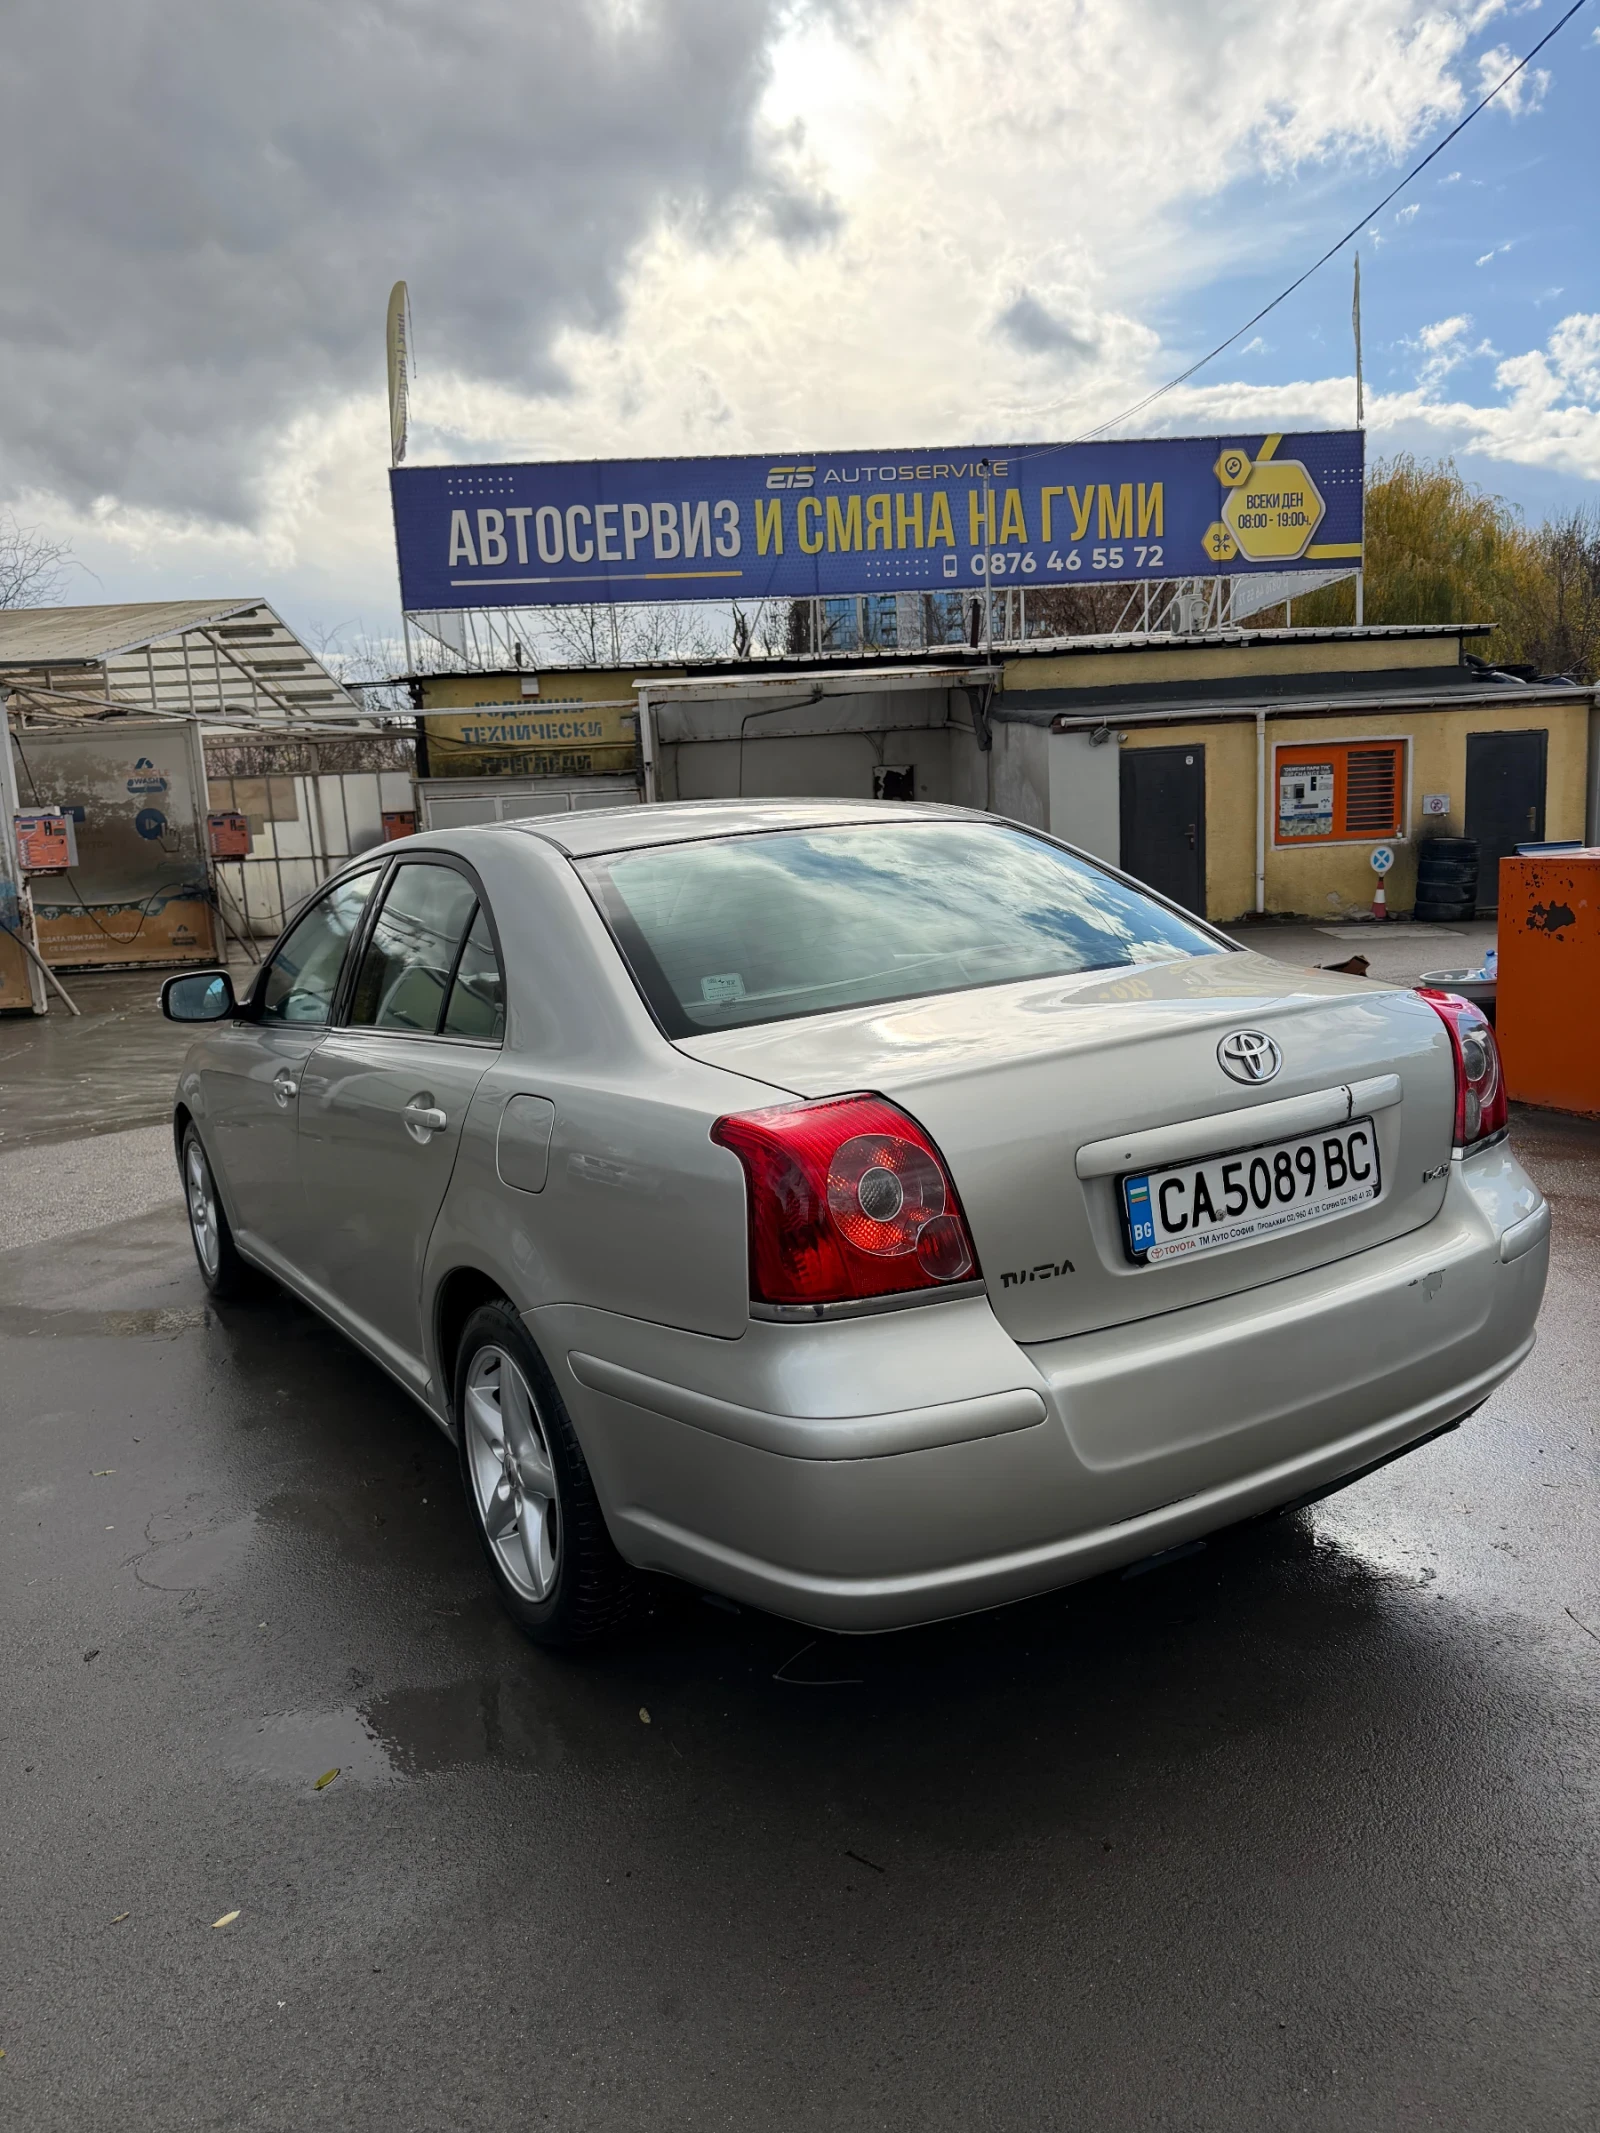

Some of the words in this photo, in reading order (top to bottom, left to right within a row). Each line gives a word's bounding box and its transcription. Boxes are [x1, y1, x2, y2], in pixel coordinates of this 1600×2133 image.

[823, 461, 1009, 484] AUTOSERVICE
[1246, 492, 1280, 509] ВСЕКИ
[1281, 491, 1304, 509] ДЕН
[448, 499, 742, 567] АВТОСЕРВИЗ
[755, 498, 785, 556] И
[797, 490, 957, 554] СМЯНА
[968, 487, 1039, 546] НА
[1041, 481, 1165, 543] ГУМИ
[1237, 513, 1268, 529] 08:00
[970, 551, 1037, 576] 0876
[1046, 549, 1082, 571] 46
[1092, 547, 1125, 569] 55
[1134, 545, 1164, 568] 72
[461, 721, 603, 743] ТЕХНИЧЕСКИ
[1134, 1222, 1152, 1241] BG
[1164, 1240, 1196, 1255] TOYOTA
